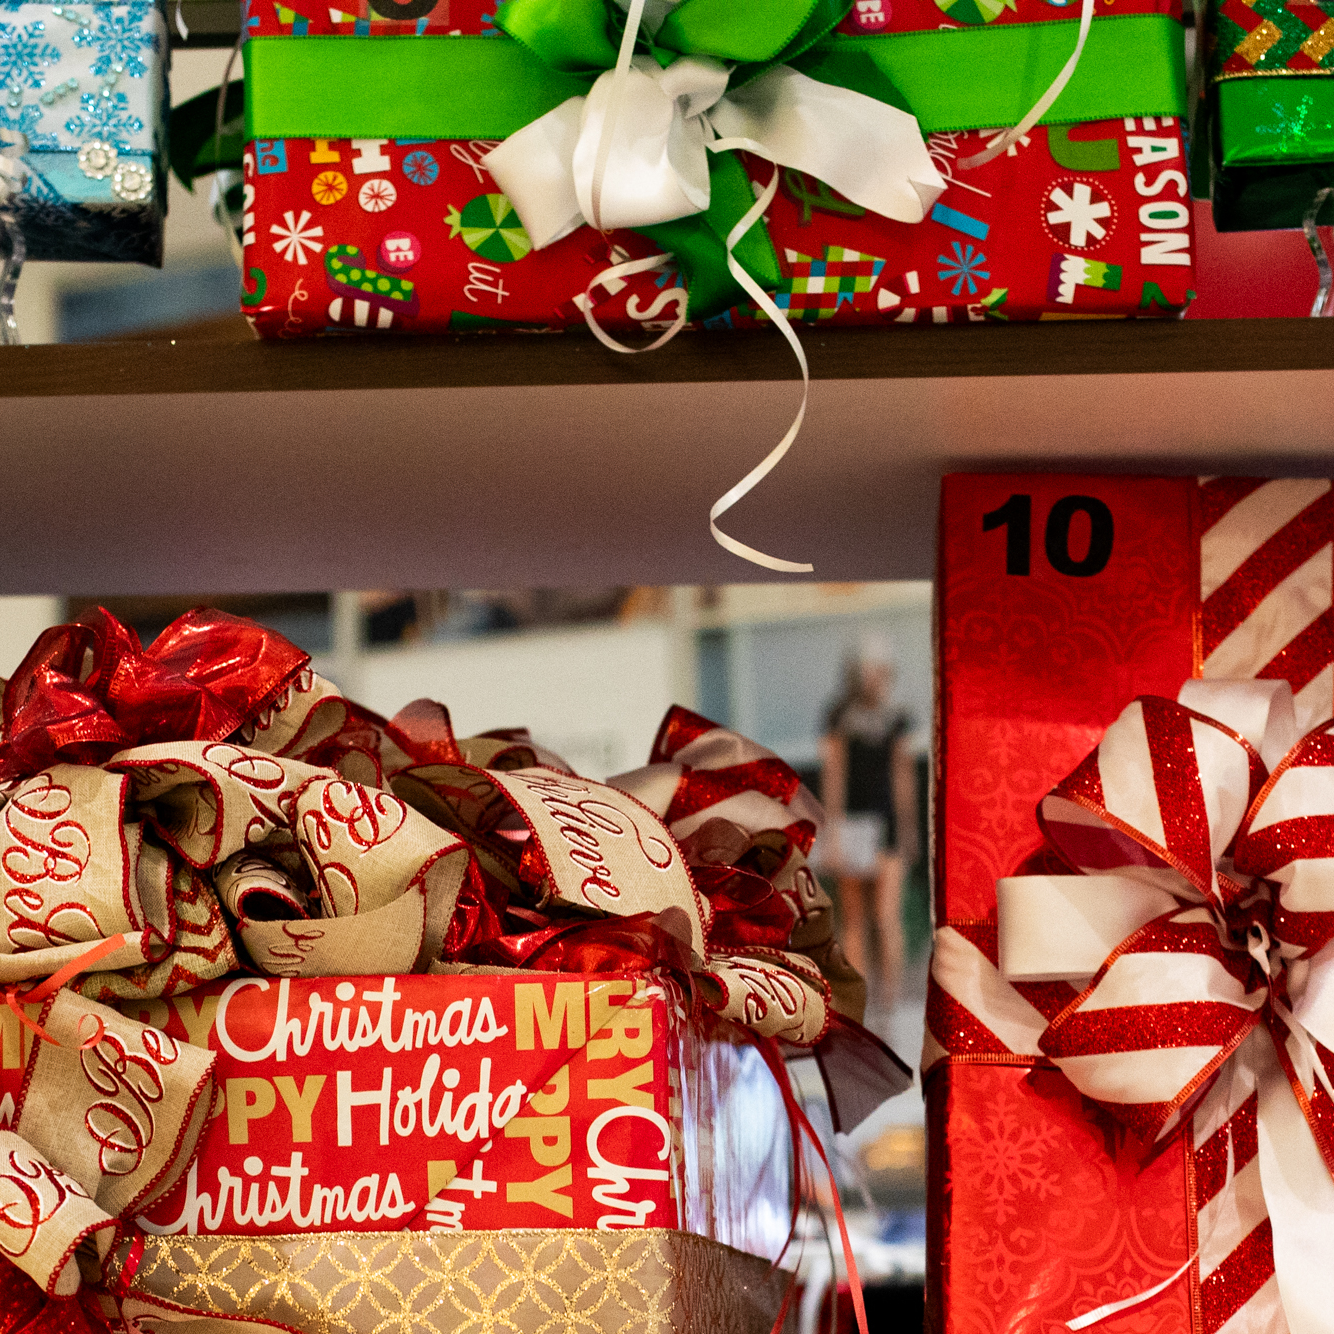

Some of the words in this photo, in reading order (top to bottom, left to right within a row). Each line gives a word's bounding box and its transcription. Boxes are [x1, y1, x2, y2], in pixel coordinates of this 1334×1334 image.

[982, 493, 1115, 578] 10
[215, 976, 509, 1063] Christmas
[136, 1151, 416, 1235] hristmas
